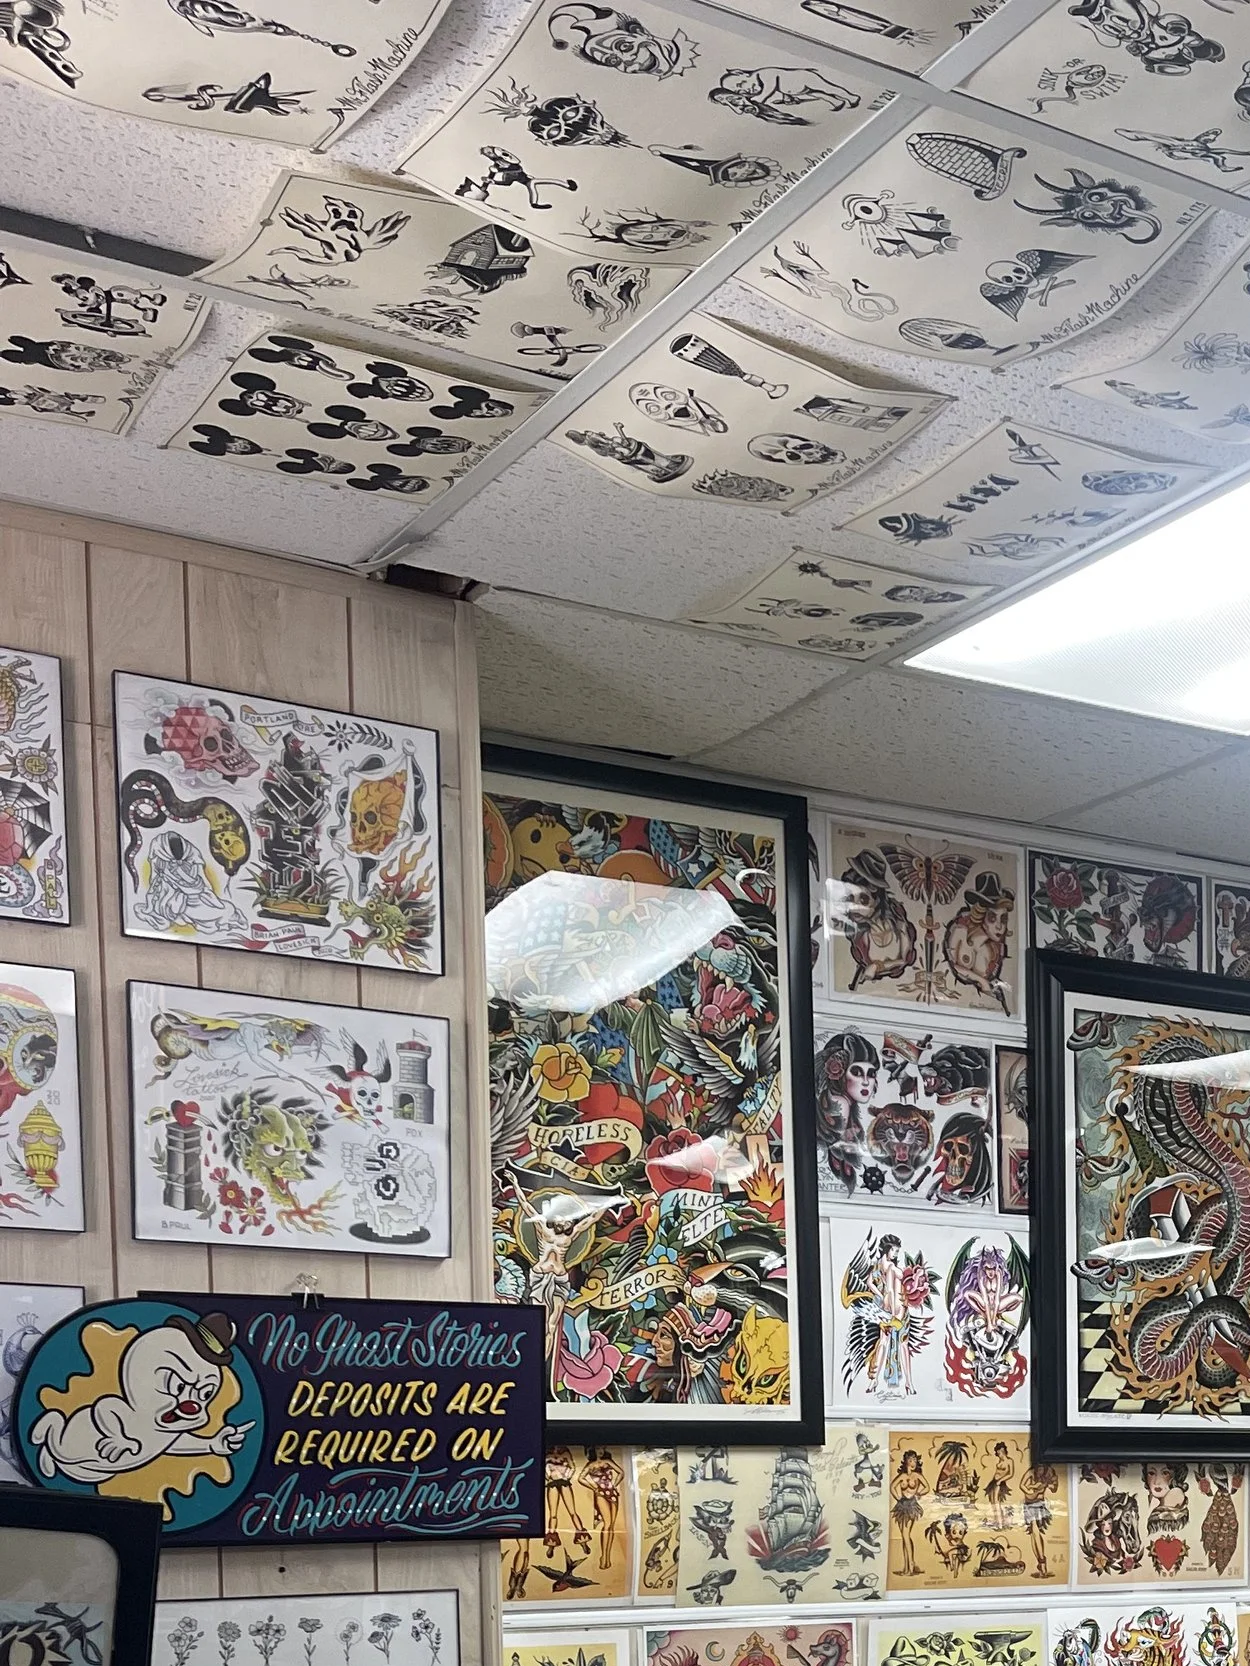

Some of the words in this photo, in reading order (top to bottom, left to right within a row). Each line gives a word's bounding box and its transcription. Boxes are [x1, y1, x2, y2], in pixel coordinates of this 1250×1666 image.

[244, 713, 294, 725] PORTLAND
[254, 930, 279, 941] BRIAN
[278, 937, 317, 951] LOVESICK
[534, 1122, 632, 1142] HOPELESS
[600, 1268, 676, 1307] TERROR
[247, 1312, 307, 1371] No
[308, 1317, 412, 1376] Ghost
[413, 1312, 528, 1371] Stories
[287, 1380, 438, 1417] DEPOSITS
[446, 1382, 516, 1415] ARE
[274, 1429, 435, 1467] REQUIRED
[451, 1427, 505, 1462] ON
[241, 1456, 536, 1537] Appointments
